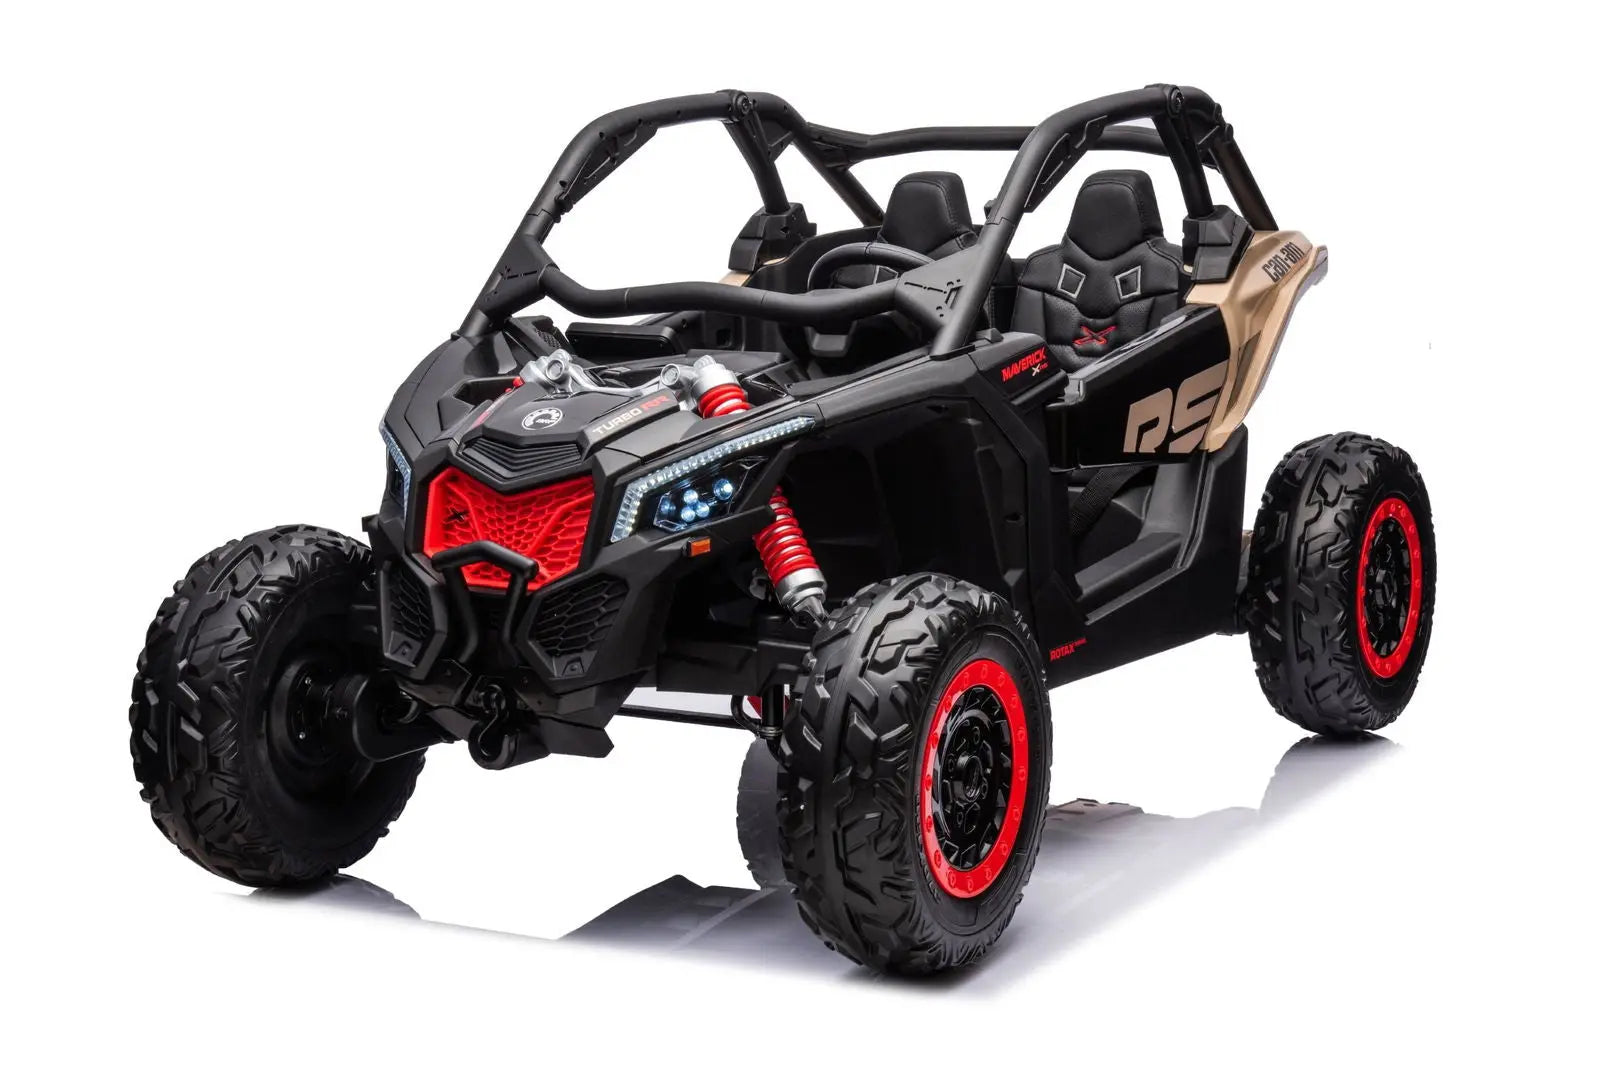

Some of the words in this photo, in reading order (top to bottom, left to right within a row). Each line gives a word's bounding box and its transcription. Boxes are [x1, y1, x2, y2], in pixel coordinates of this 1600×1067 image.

[1001, 346, 1046, 382] MAVERICK
[592, 407, 642, 434] TURBO
[1123, 360, 1229, 453] RS
[1050, 644, 1075, 661] ROTAX
